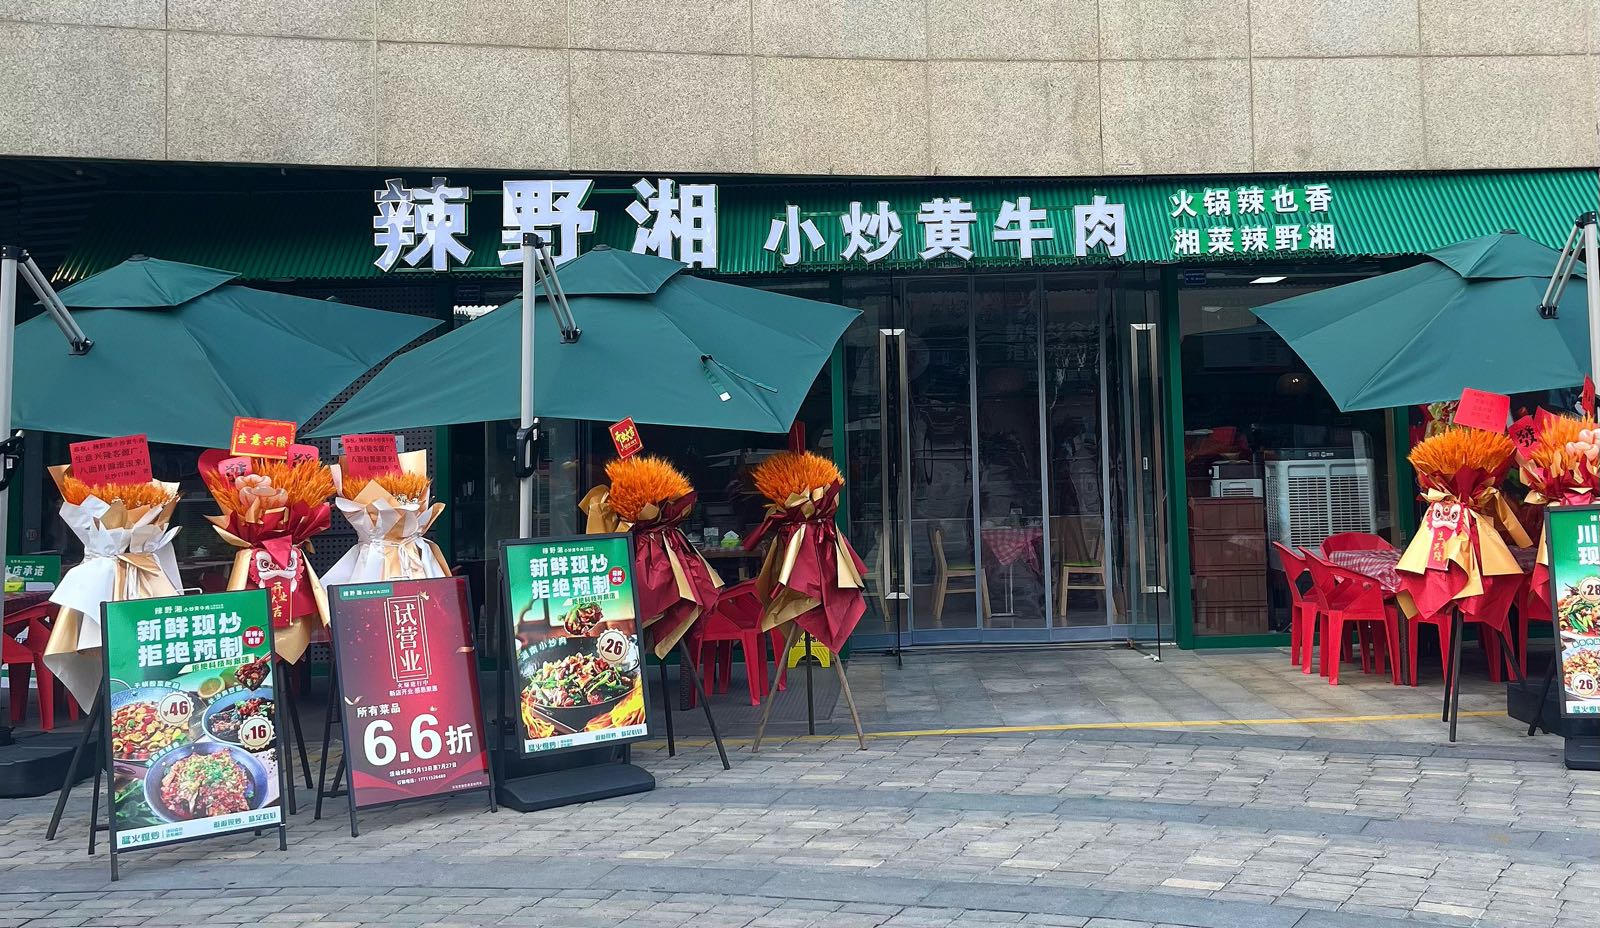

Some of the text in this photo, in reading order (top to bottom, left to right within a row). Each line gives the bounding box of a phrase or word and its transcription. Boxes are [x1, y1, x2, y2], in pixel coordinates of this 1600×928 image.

[1170, 184, 1334, 219] 火锅辣也香
[374, 178, 719, 272] 辣野湘
[764, 195, 1127, 266] 小炒黄牛肉
[1173, 223, 1336, 256] 湘菜辣野湘
[237, 433, 288, 448] 生意兴隆
[529, 553, 609, 578] 新鲜现炒
[531, 574, 611, 600] 拒绝预制
[137, 612, 242, 642] 新鲜现炒
[393, 603, 423, 673] 试营业
[138, 635, 243, 667] 拒绝预制
[356, 702, 401, 718] 所有菜品
[364, 713, 474, 766] 6.6折
